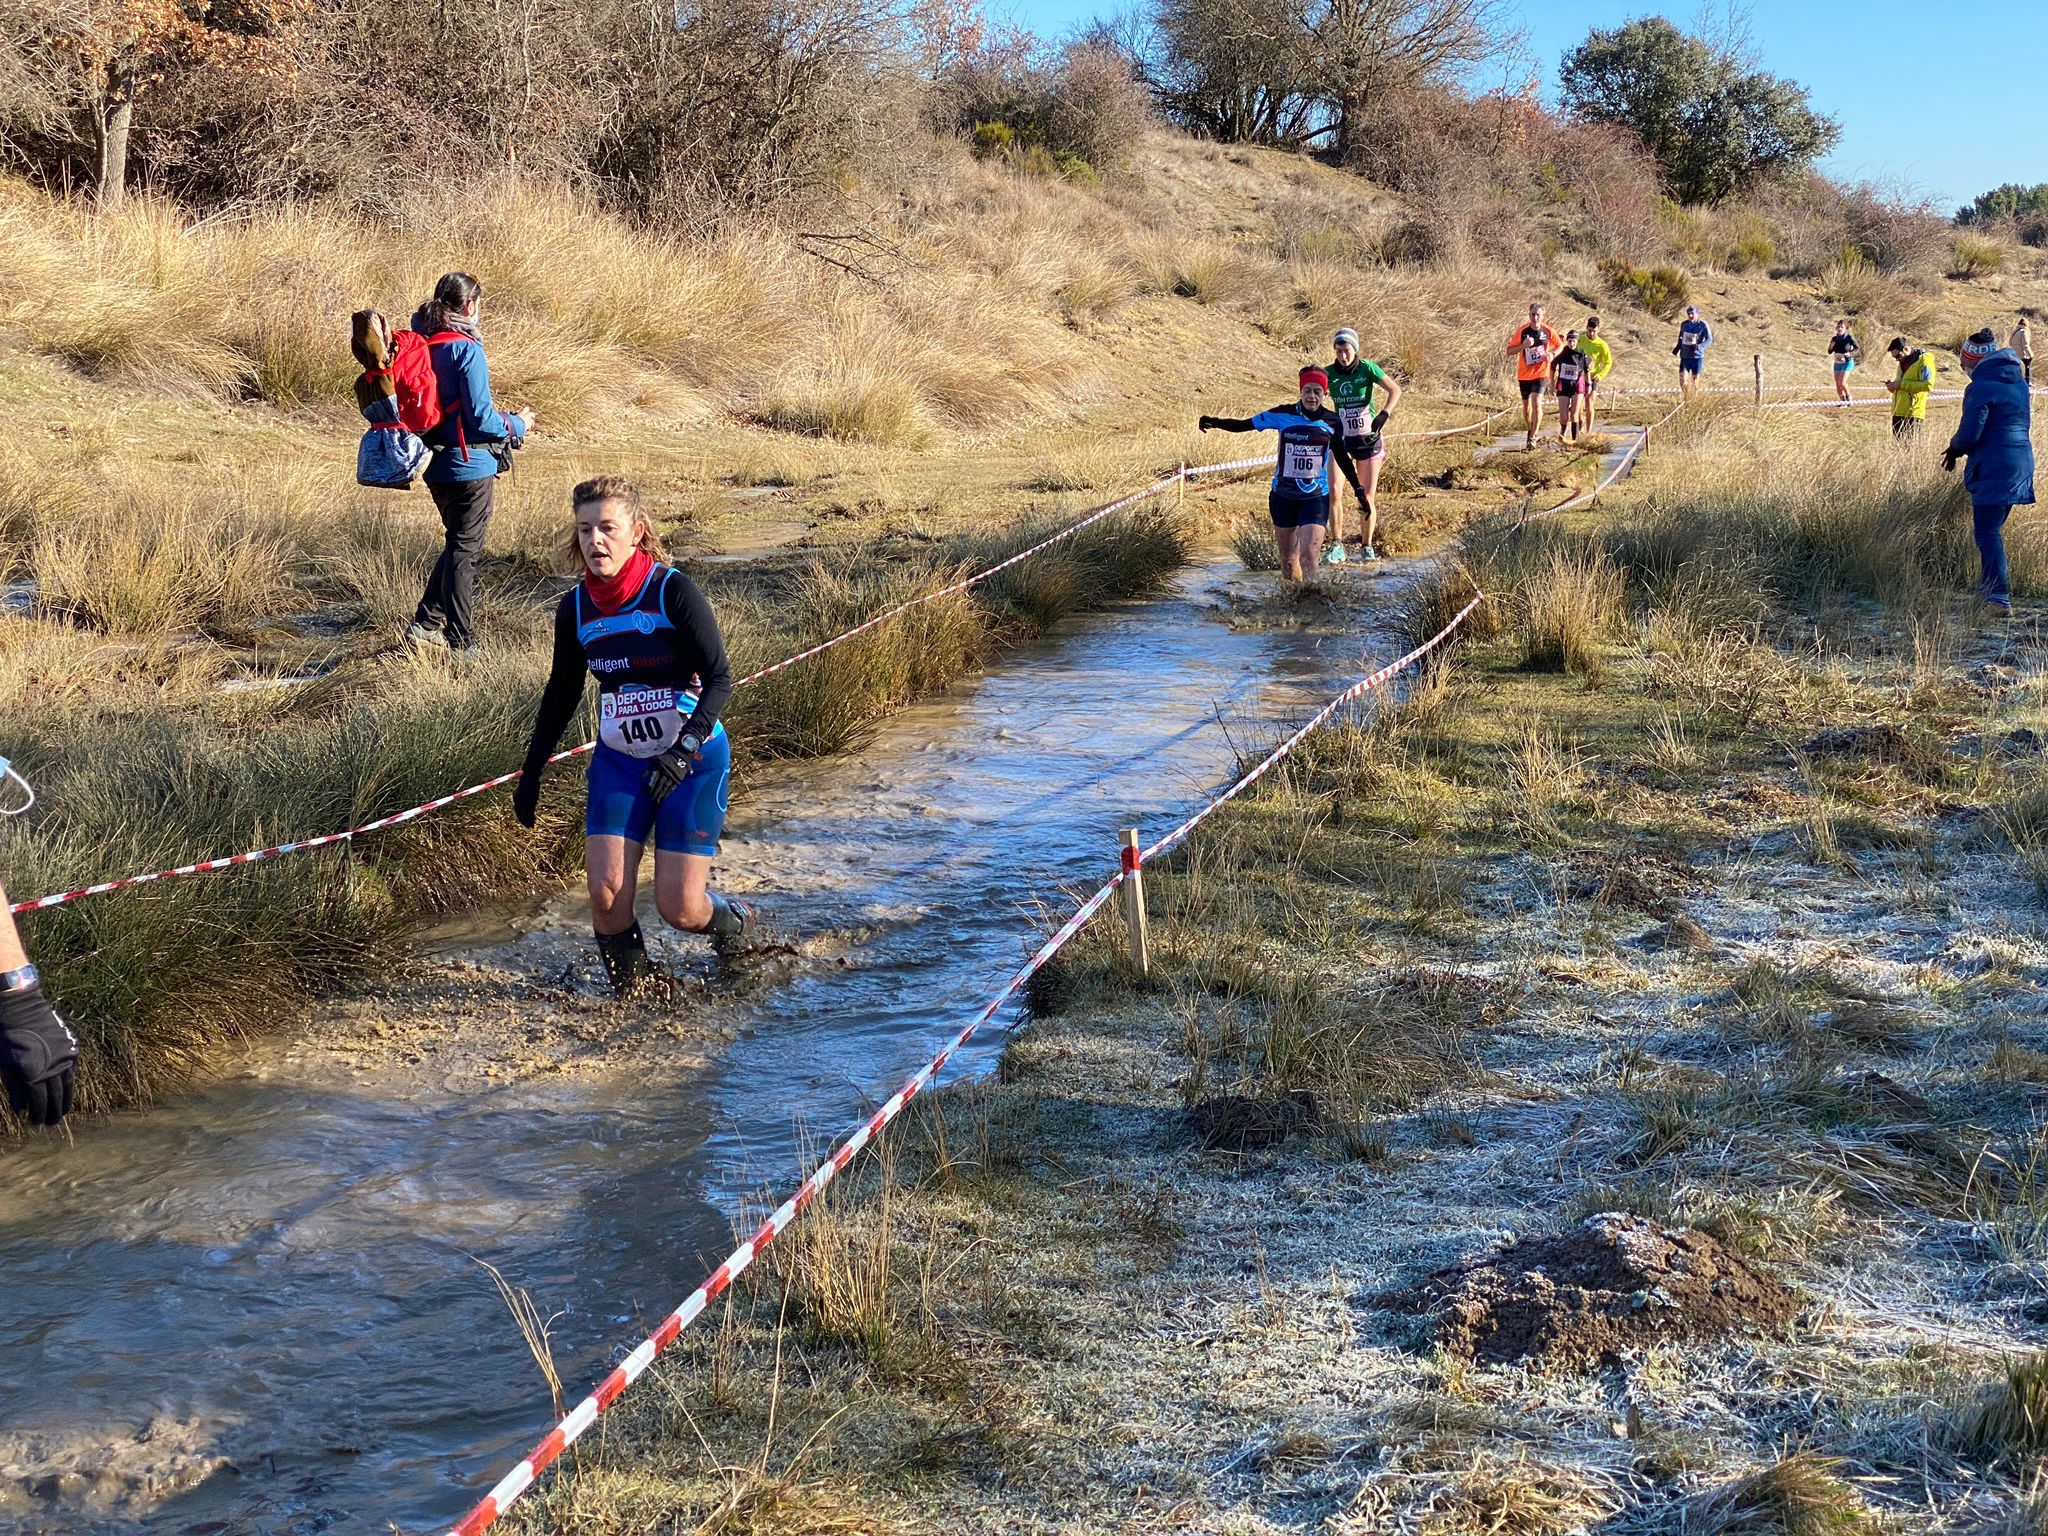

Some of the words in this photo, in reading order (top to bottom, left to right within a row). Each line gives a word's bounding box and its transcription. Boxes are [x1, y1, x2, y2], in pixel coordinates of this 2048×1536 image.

[1347, 418, 1364, 429] 109
[1293, 458, 1313, 470] 106
[617, 688, 673, 705] DEPORTE
[618, 704, 639, 715] PARA
[640, 699, 673, 712] TODOS
[618, 716, 663, 745] 140
